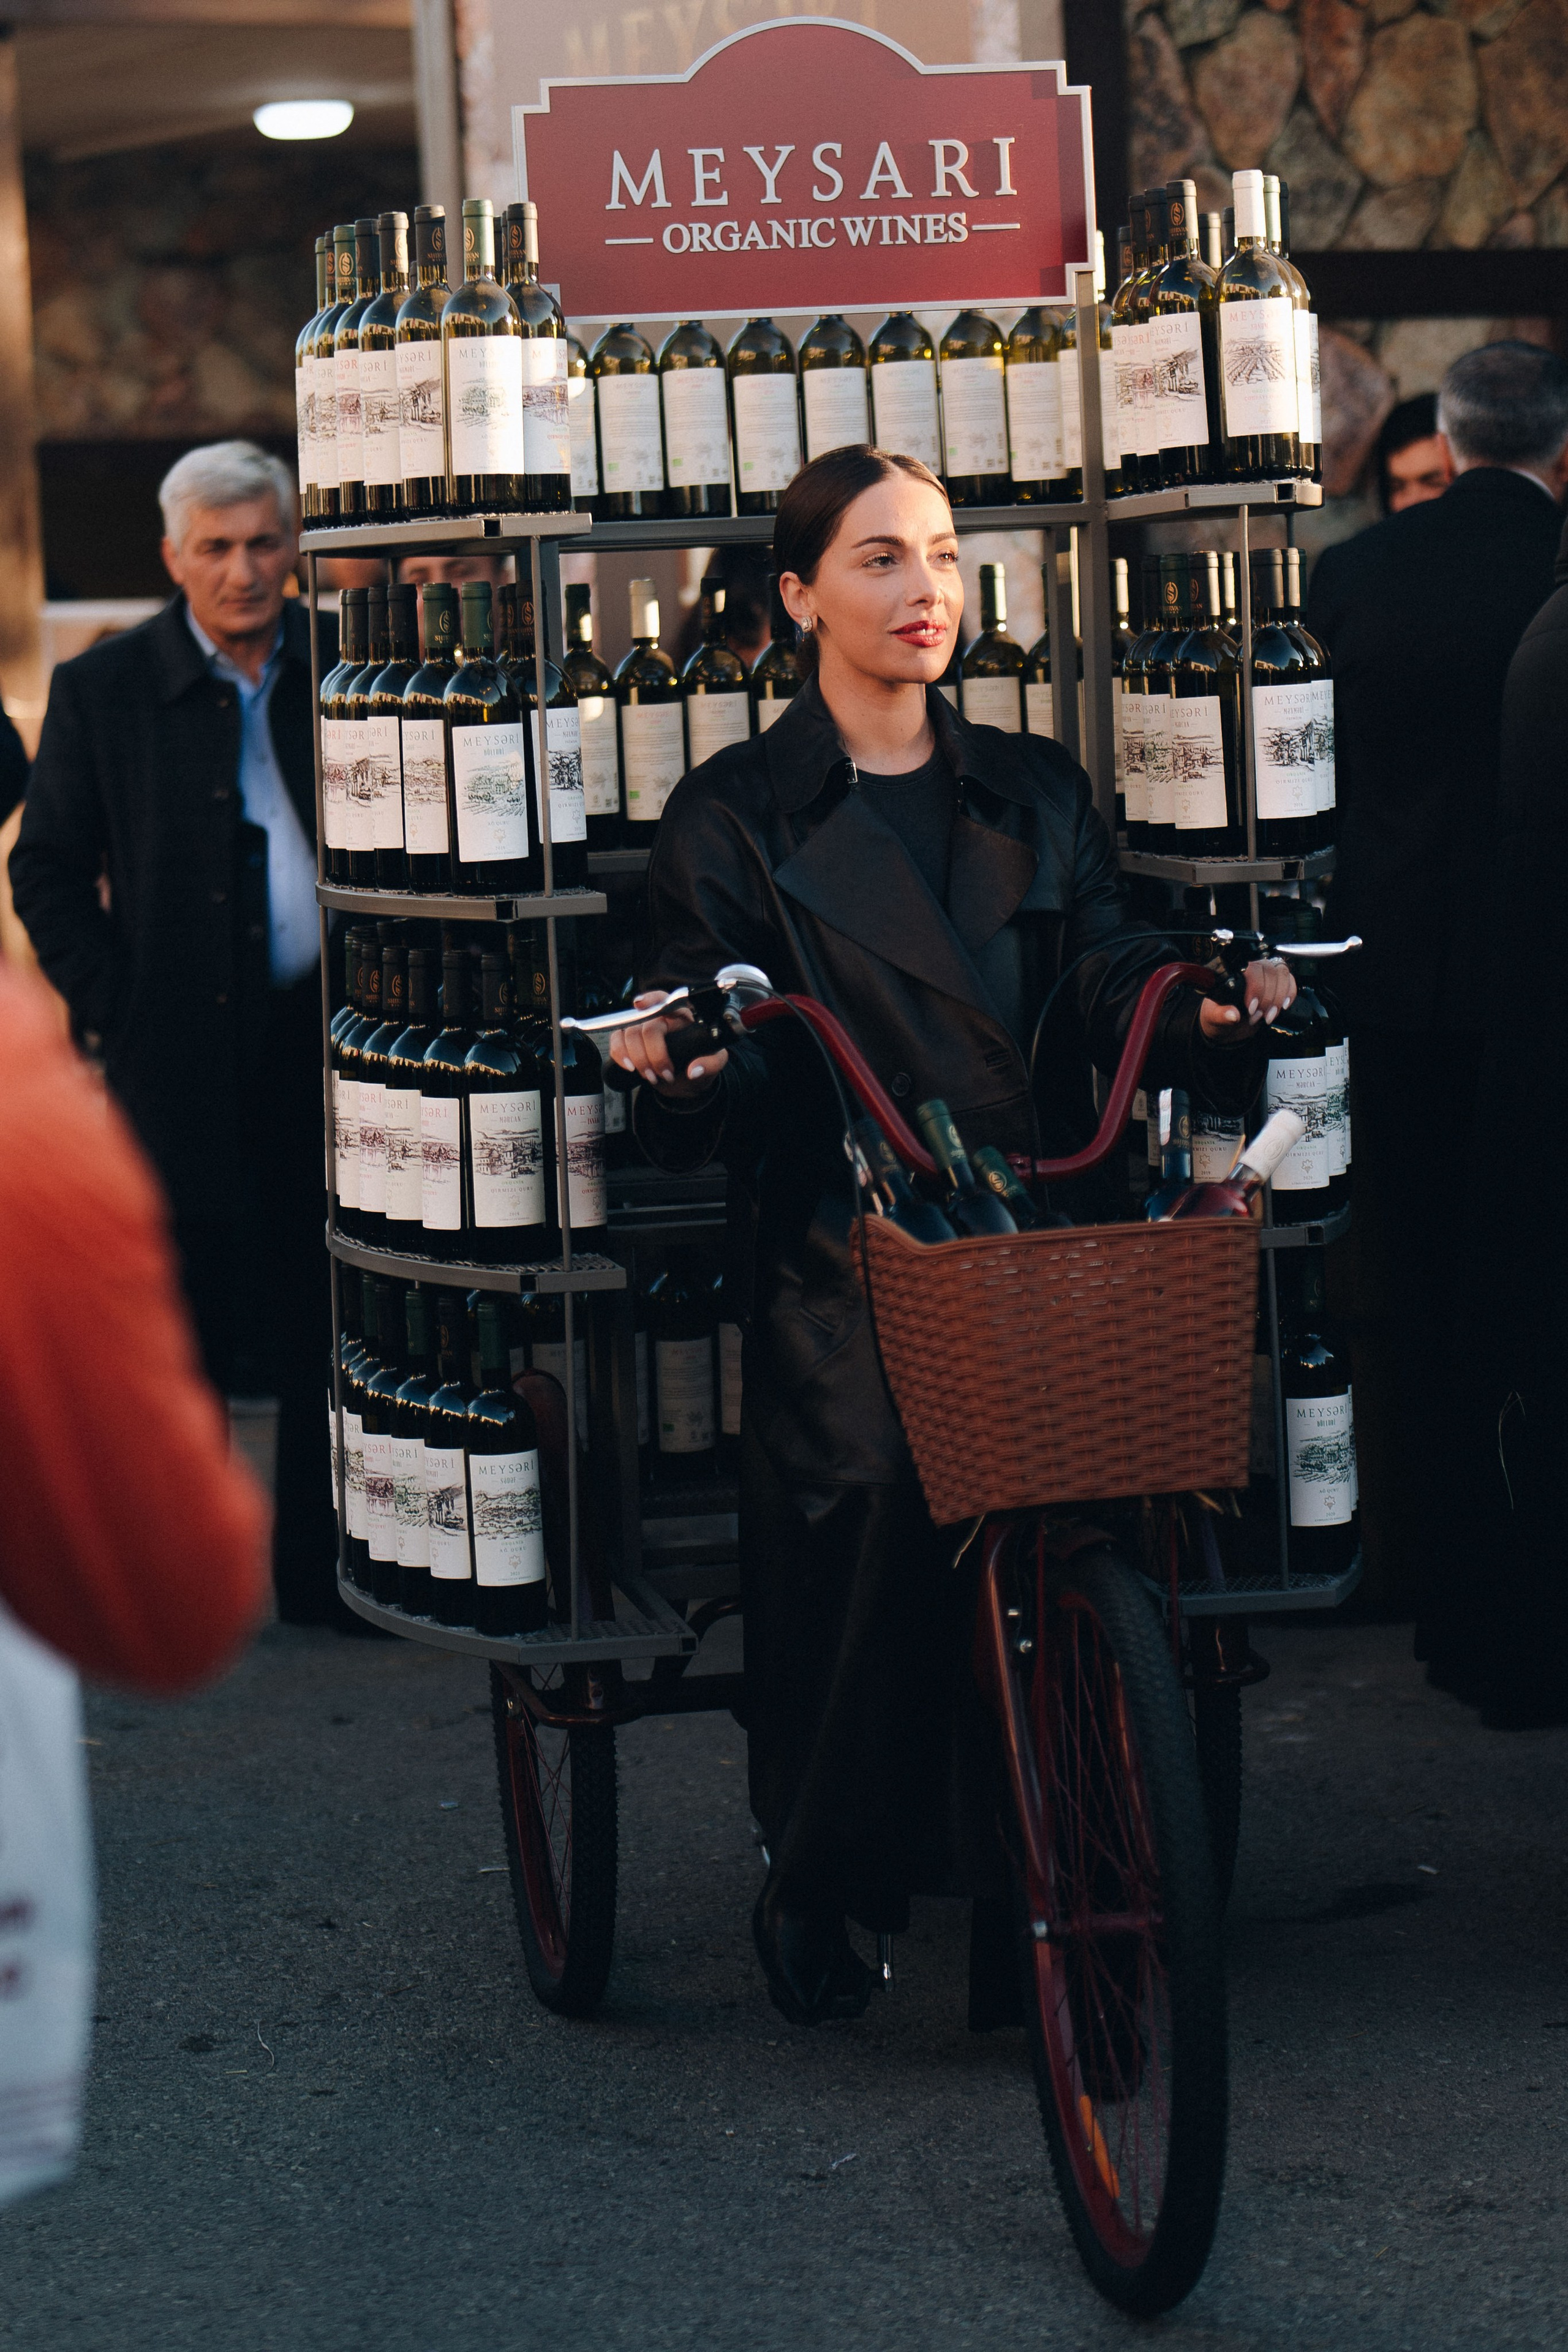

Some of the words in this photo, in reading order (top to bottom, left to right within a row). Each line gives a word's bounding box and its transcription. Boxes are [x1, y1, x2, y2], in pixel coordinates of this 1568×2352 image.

[605, 137, 1017, 210] MEYSARI
[662, 217, 837, 254] ORGANIC
[840, 213, 968, 247] WINES
[1150, 322, 1188, 336] EYSƏRİ
[398, 349, 431, 363] YSƏRİ
[1144, 703, 1166, 715] SƏRİ
[1170, 706, 1208, 718] EYSƏRİ
[546, 717, 580, 729] MEYSƏ
[402, 729, 435, 741] YSƏRİ
[463, 734, 519, 747] MEYSƏRİ
[386, 1099, 409, 1109] SƏRİ
[480, 1100, 536, 1114] MEYSƏRİ
[421, 1107, 447, 1118] SƏRİ
[567, 1104, 603, 1117] MEYSƏ
[1297, 1404, 1347, 1419] MEYSƏRİ
[363, 1442, 392, 1454] YSƏRİ
[394, 1448, 418, 1458] SƏRİ
[425, 1458, 454, 1469] YSƏRİ
[479, 1459, 533, 1475] MEYSƏRİ
